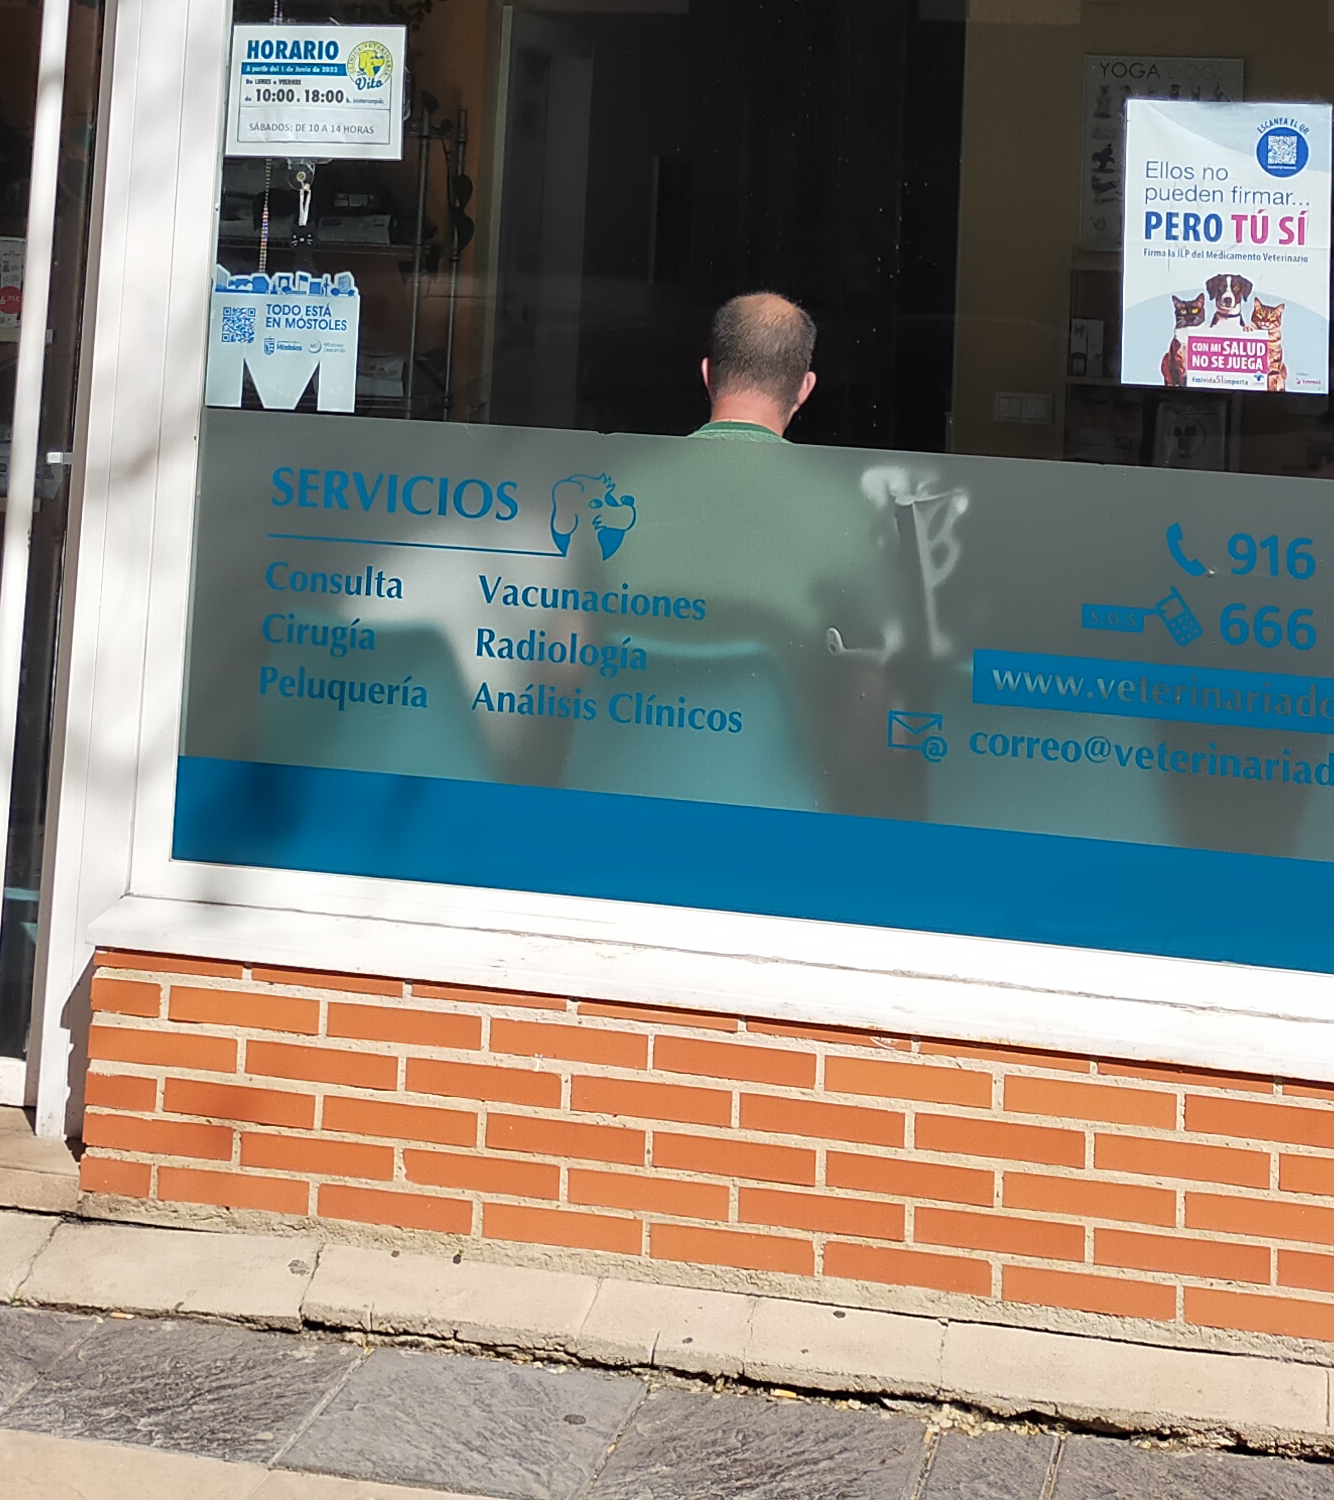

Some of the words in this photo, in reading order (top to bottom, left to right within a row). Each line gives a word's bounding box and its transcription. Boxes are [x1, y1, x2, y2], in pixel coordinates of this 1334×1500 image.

[247, 39, 339, 61] HORARIO
[1099, 61, 1160, 79] YOGA
[355, 76, 384, 91] Vito
[256, 88, 295, 103] 10:00
[304, 89, 344, 104] 18:00
[249, 122, 293, 132] SÁBADOS:
[295, 124, 307, 132] DE
[309, 124, 319, 132] 10
[321, 125, 328, 133] A
[330, 125, 341, 133] 14
[343, 125, 375, 134] HORAS
[1289, 118, 1299, 129] EL
[1145, 160, 1195, 180] Ellos
[1202, 167, 1229, 181] no
[1144, 185, 1224, 205] pueden
[1231, 186, 1310, 206] firmar...
[1144, 211, 1223, 243] PERO
[1231, 208, 1268, 244] TÚ
[1278, 210, 1308, 246] SÍ
[1143, 248, 1166, 258] Firma
[1167, 249, 1176, 258] la
[1177, 250, 1190, 259] ILP
[1191, 250, 1205, 260] del
[1206, 250, 1261, 262] Medicamento
[1262, 252, 1309, 264] Veterinario
[265, 303, 302, 316] TODO
[305, 302, 332, 318] ESTÁ
[265, 317, 281, 328] EN
[284, 315, 348, 332] MÓSTOLES
[1191, 342, 1209, 353] CON
[1210, 343, 1222, 353] MI
[1222, 341, 1266, 356] SALUD
[1191, 354, 1210, 368] NO
[1211, 356, 1225, 369] SE
[1226, 357, 1264, 371] JUEGA
[271, 466, 519, 521] SERVICIOS
[1226, 532, 1317, 580] 916
[265, 561, 404, 600] Consulta
[478, 574, 707, 620] Vacunaciones
[261, 612, 376, 658] Cirugía
[1219, 602, 1317, 651] 666
[475, 627, 648, 679] Radiología
[258, 666, 429, 711] Peluquería
[471, 681, 597, 721] Análisis
[608, 691, 744, 733] Clínicos
